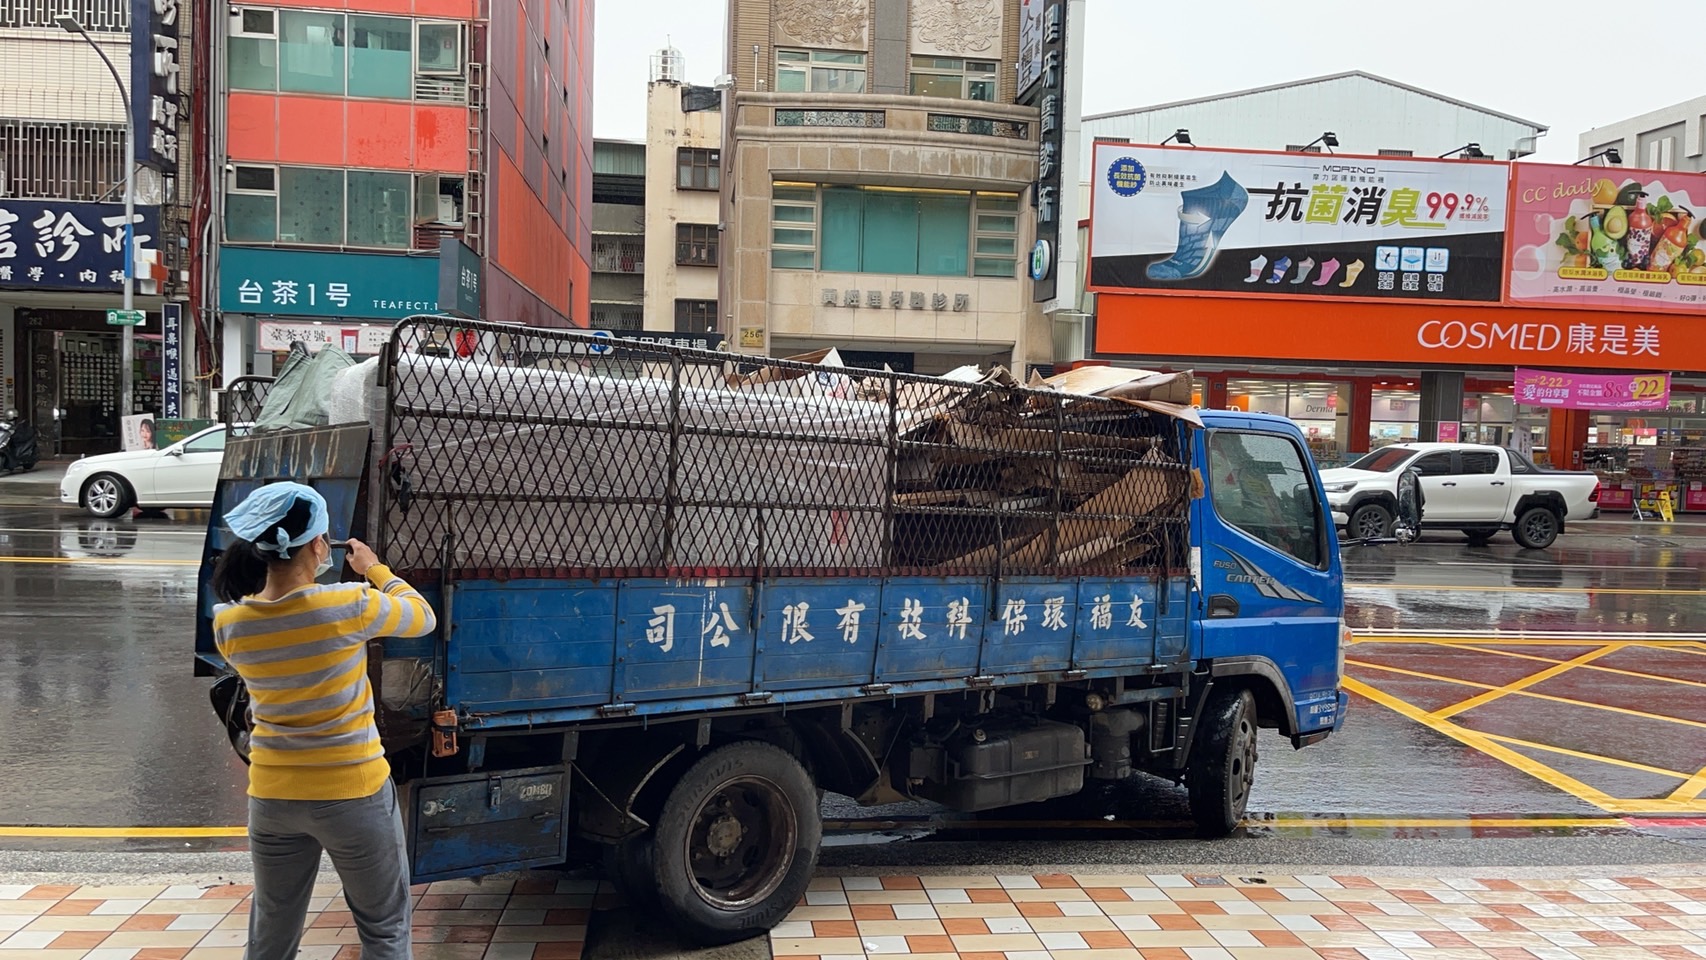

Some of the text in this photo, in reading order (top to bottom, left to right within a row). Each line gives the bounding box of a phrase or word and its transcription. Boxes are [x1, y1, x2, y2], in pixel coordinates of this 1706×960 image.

[1322, 165, 1376, 174] MORINO
[1522, 177, 1604, 204] CC daily
[238, 279, 352, 308] 台茶1号
[1417, 320, 1561, 351] COSMED
[1565, 322, 1661, 357] 康是美
[1638, 379, 1659, 398] 22
[1213, 560, 1238, 570] FUSO
